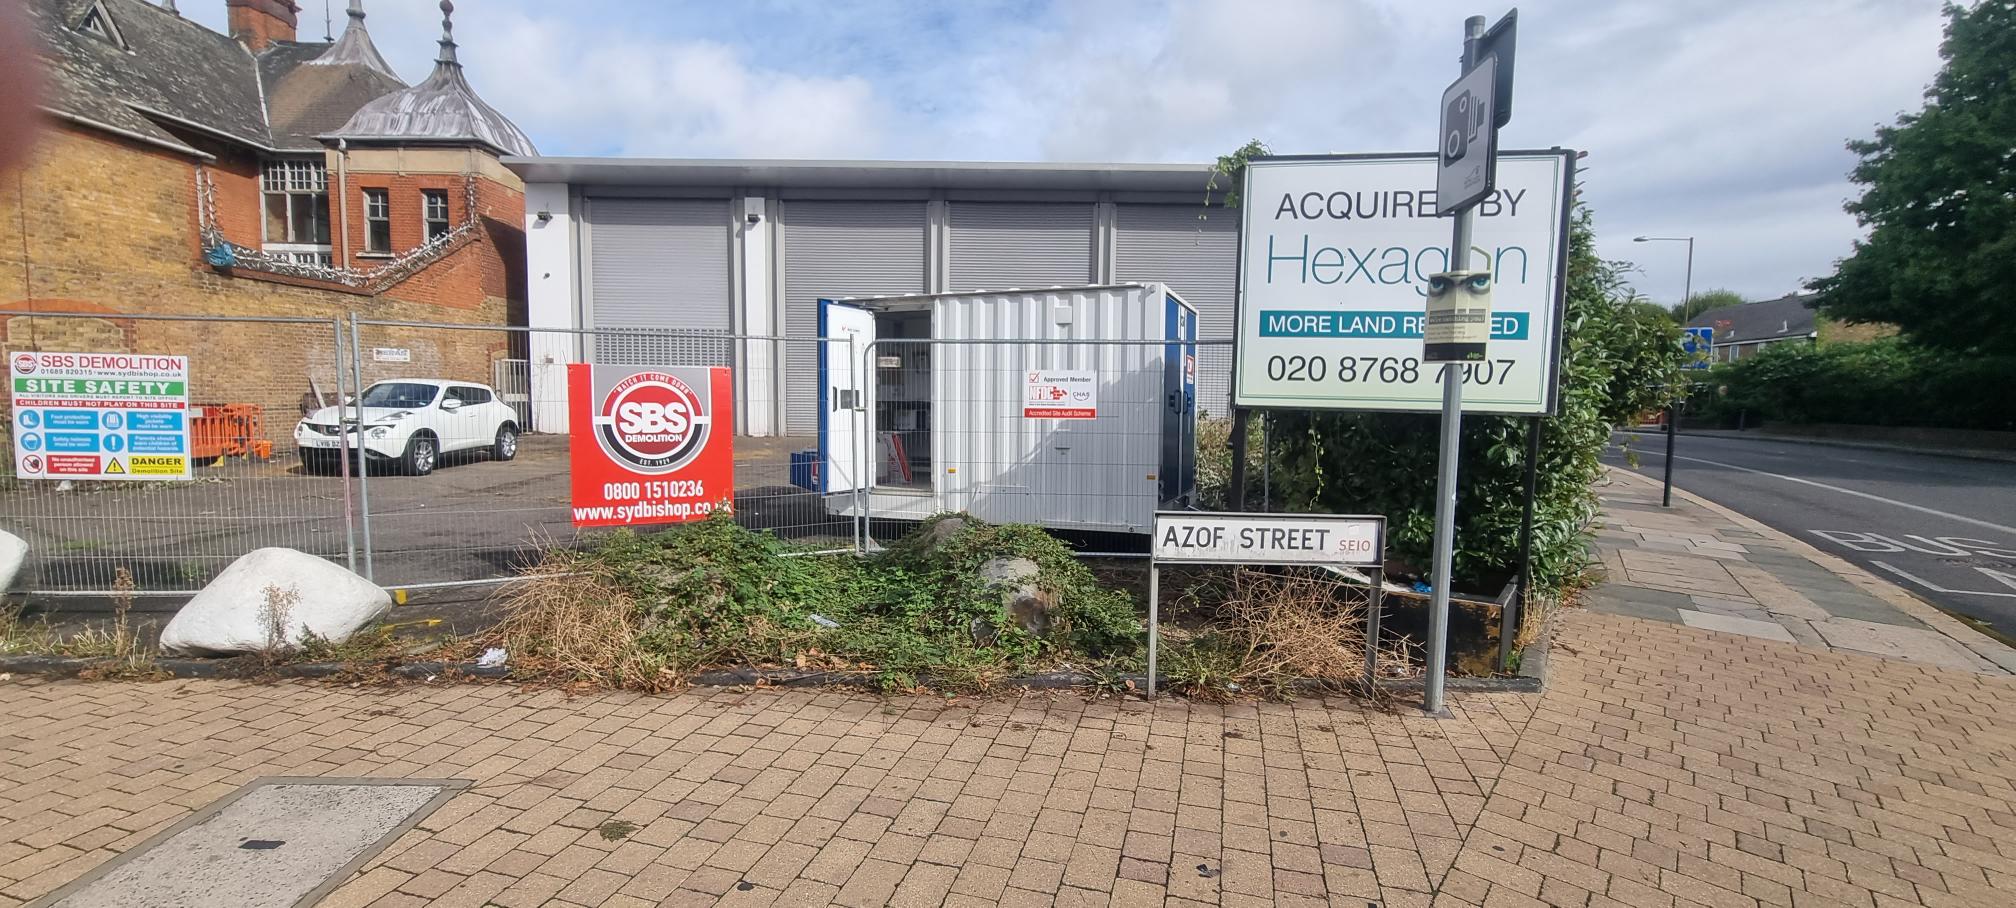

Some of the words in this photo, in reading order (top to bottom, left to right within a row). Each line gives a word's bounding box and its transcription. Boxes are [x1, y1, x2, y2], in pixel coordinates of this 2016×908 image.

[1275, 190, 1455, 220] ACQUIRE
[1480, 189, 1526, 217] BY
[1269, 315, 1331, 333] MORE
[1338, 316, 1396, 334] LAND
[41, 355, 75, 368] SBS
[79, 356, 182, 370] DEMOLITION
[1267, 355, 1327, 382] 020
[1338, 356, 1420, 384] 8768
[26, 379, 76, 393] SITE
[85, 380, 170, 395] SAFETY
[619, 402, 687, 433] SBS
[625, 433, 682, 442] DEMOLITION
[132, 457, 182, 465] DANGER
[604, 483, 640, 500] 0800
[645, 480, 704, 498] 1510236
[1162, 525, 1225, 548] AZOF
[1239, 527, 1330, 550] STREET
